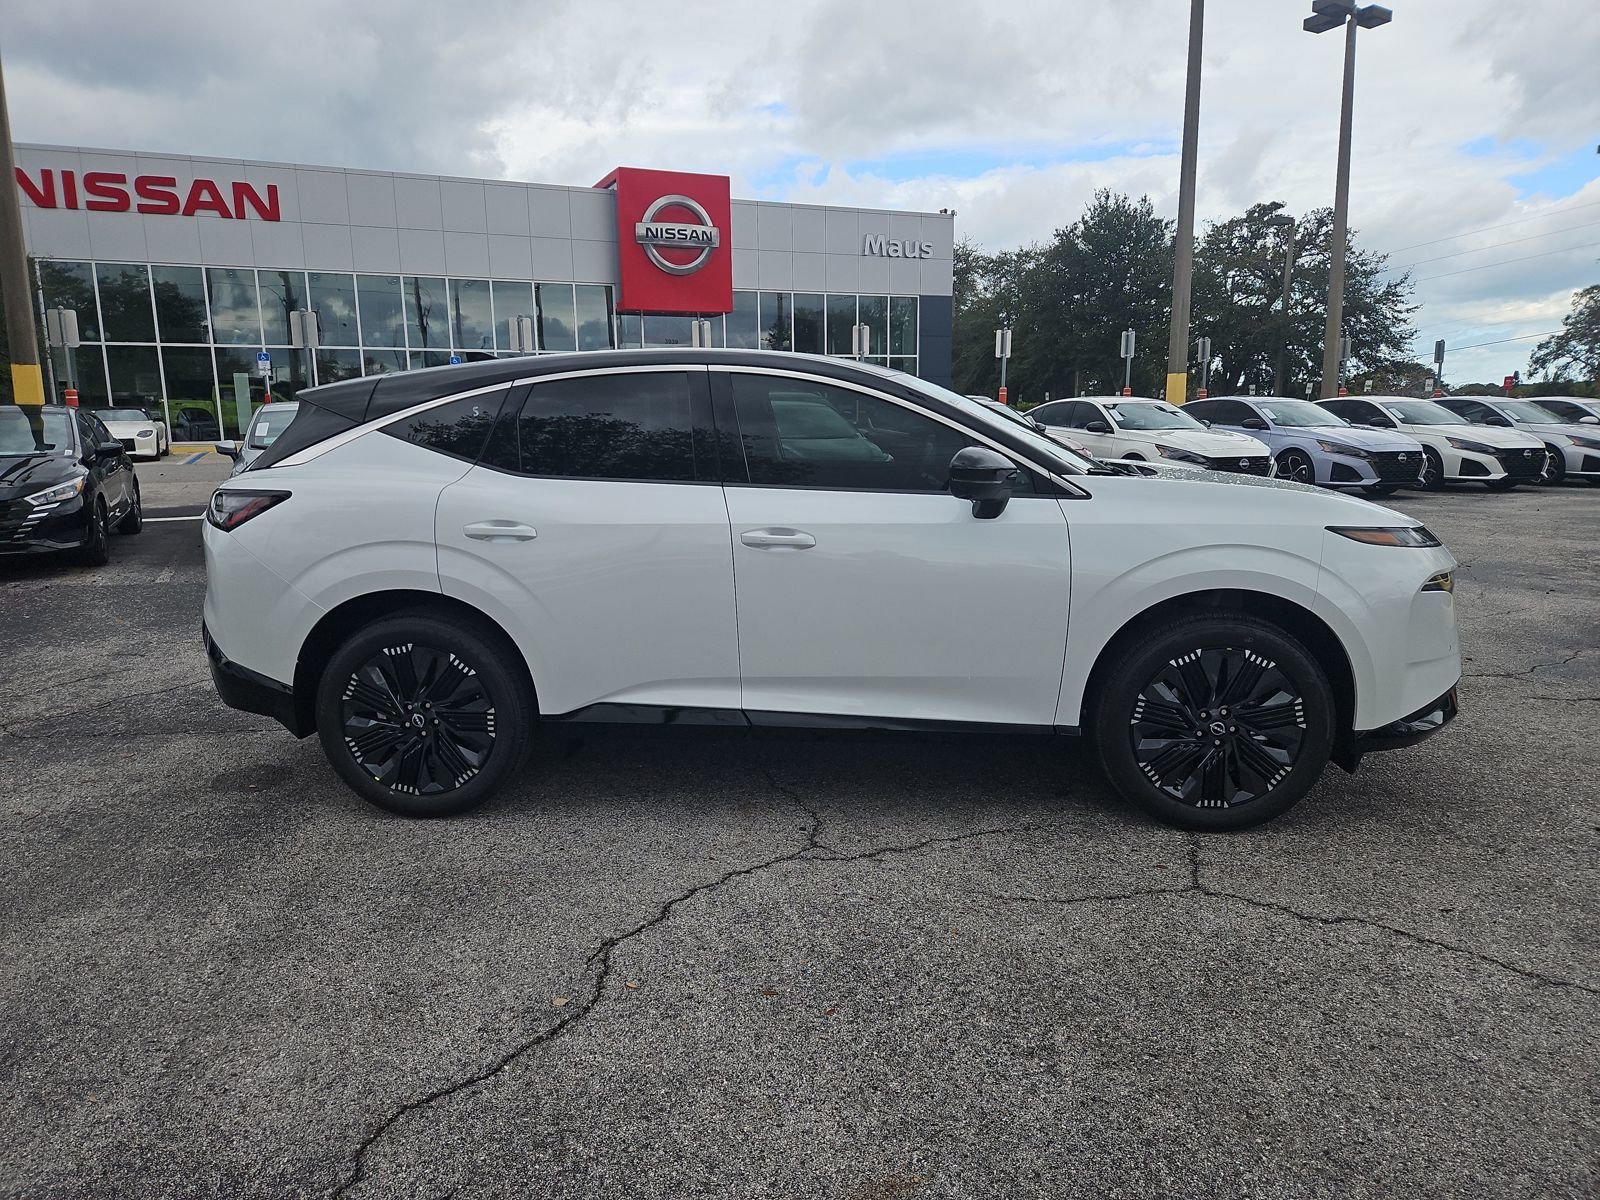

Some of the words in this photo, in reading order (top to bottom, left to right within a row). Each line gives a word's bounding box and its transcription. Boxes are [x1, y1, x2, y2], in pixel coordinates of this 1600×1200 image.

[15, 167, 280, 222] NISSAN
[645, 227, 713, 242] NISSAN
[864, 233, 934, 258] Maus
